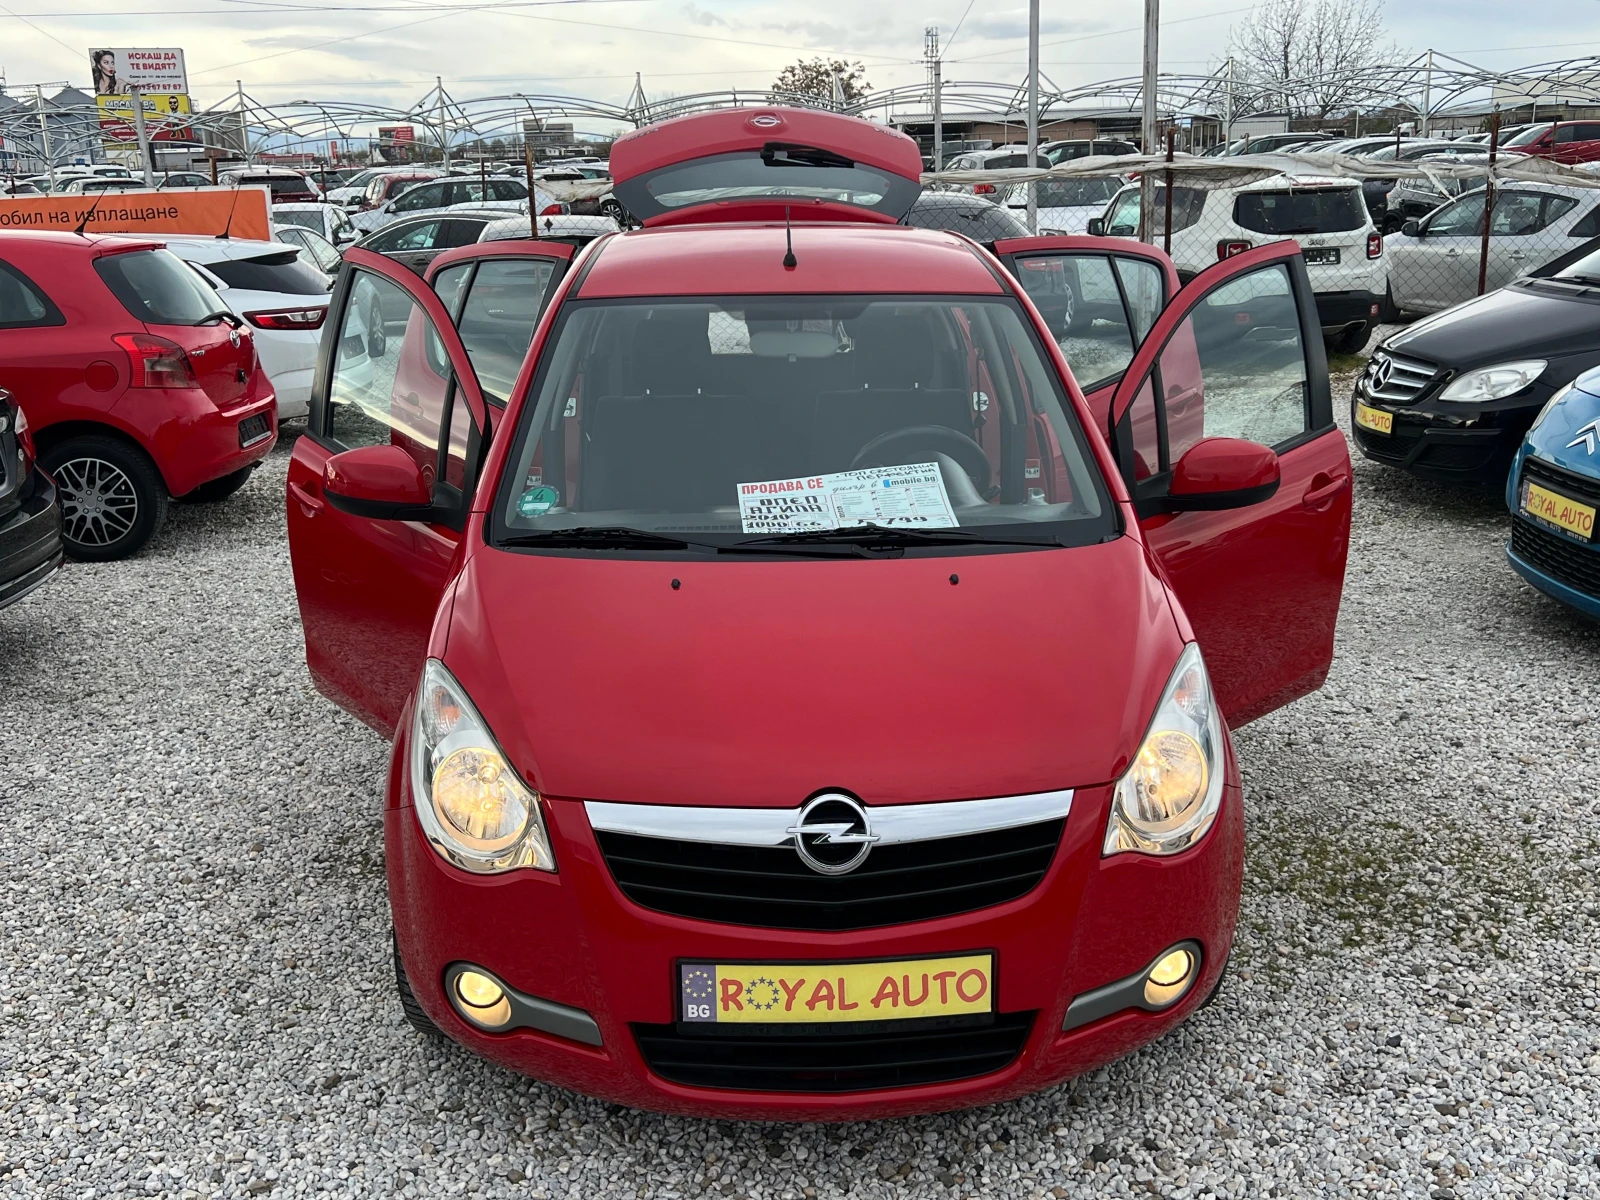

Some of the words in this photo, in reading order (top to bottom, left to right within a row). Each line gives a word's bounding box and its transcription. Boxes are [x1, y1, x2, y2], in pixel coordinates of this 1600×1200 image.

[128, 52, 161, 60] ИСКАШ
[163, 52, 177, 61] ДА
[130, 62, 141, 70] ТЕ
[142, 62, 177, 71] ВИДЯТ?
[48, 210, 70, 224] на
[75, 206, 179, 223] изплащане
[1369, 413, 1391, 430] AUTO
[741, 479, 804, 495] ПРОДАВА
[807, 477, 825, 489] СЕ
[891, 475, 936, 486] mobile.bg
[533, 489, 545, 502] 4
[1559, 505, 1593, 532] AUTO
[719, 976, 859, 1012] ROYAL
[870, 968, 988, 1009] AUTO
[687, 1003, 711, 1019] BG
